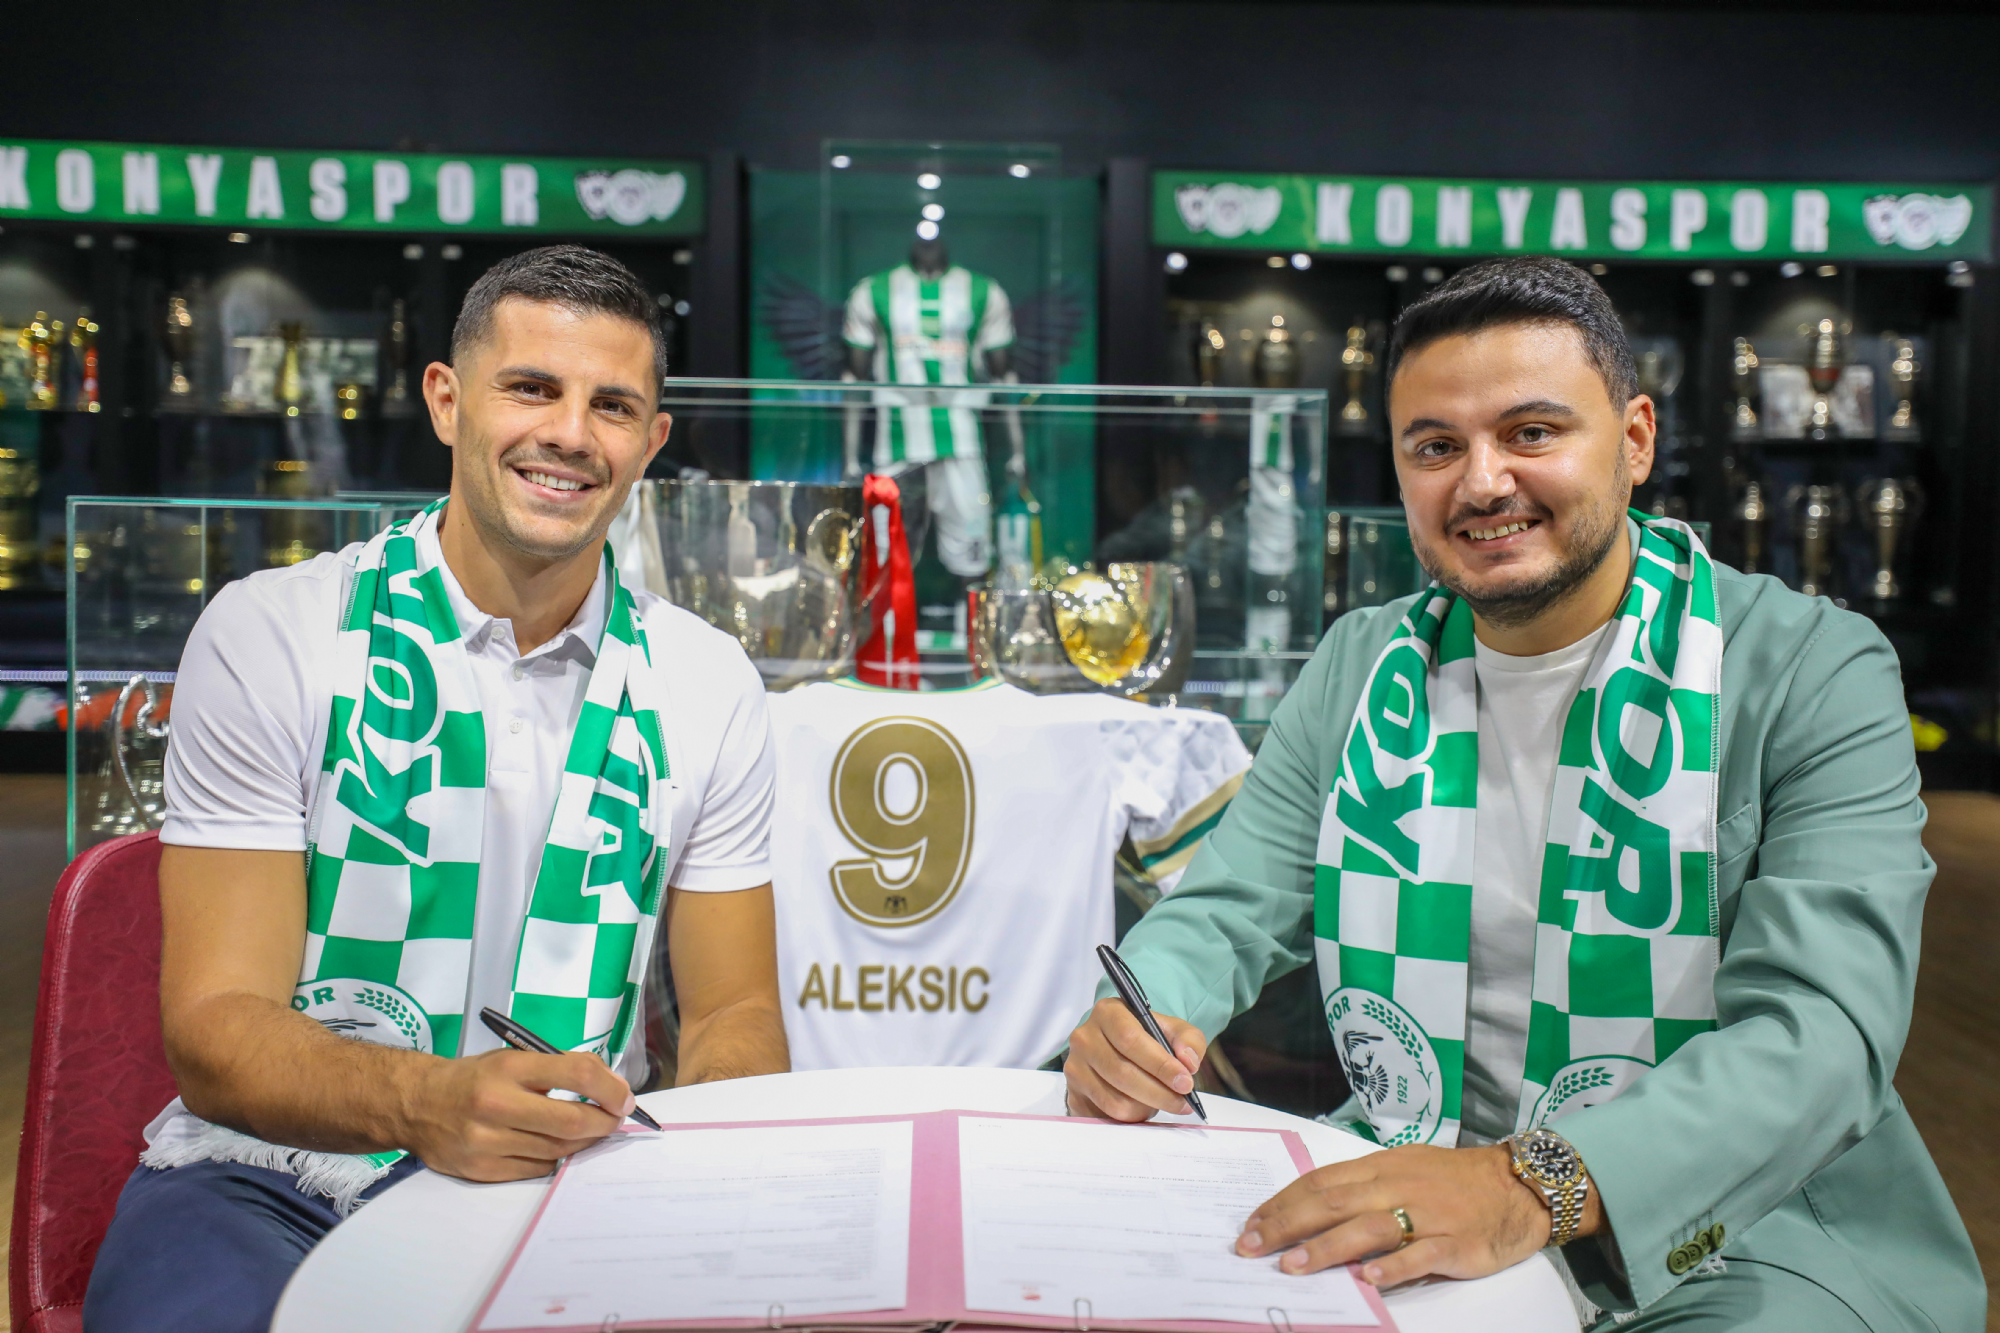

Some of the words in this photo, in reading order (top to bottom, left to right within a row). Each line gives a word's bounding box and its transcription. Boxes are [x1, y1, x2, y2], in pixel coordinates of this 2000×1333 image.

[0, 147, 539, 227] KONYASPOR
[1316, 184, 1830, 253] KONYASPOR
[828, 715, 976, 929] 9
[799, 963, 990, 1013] ALEKSIC
[1397, 1075, 1408, 1105] 1922
